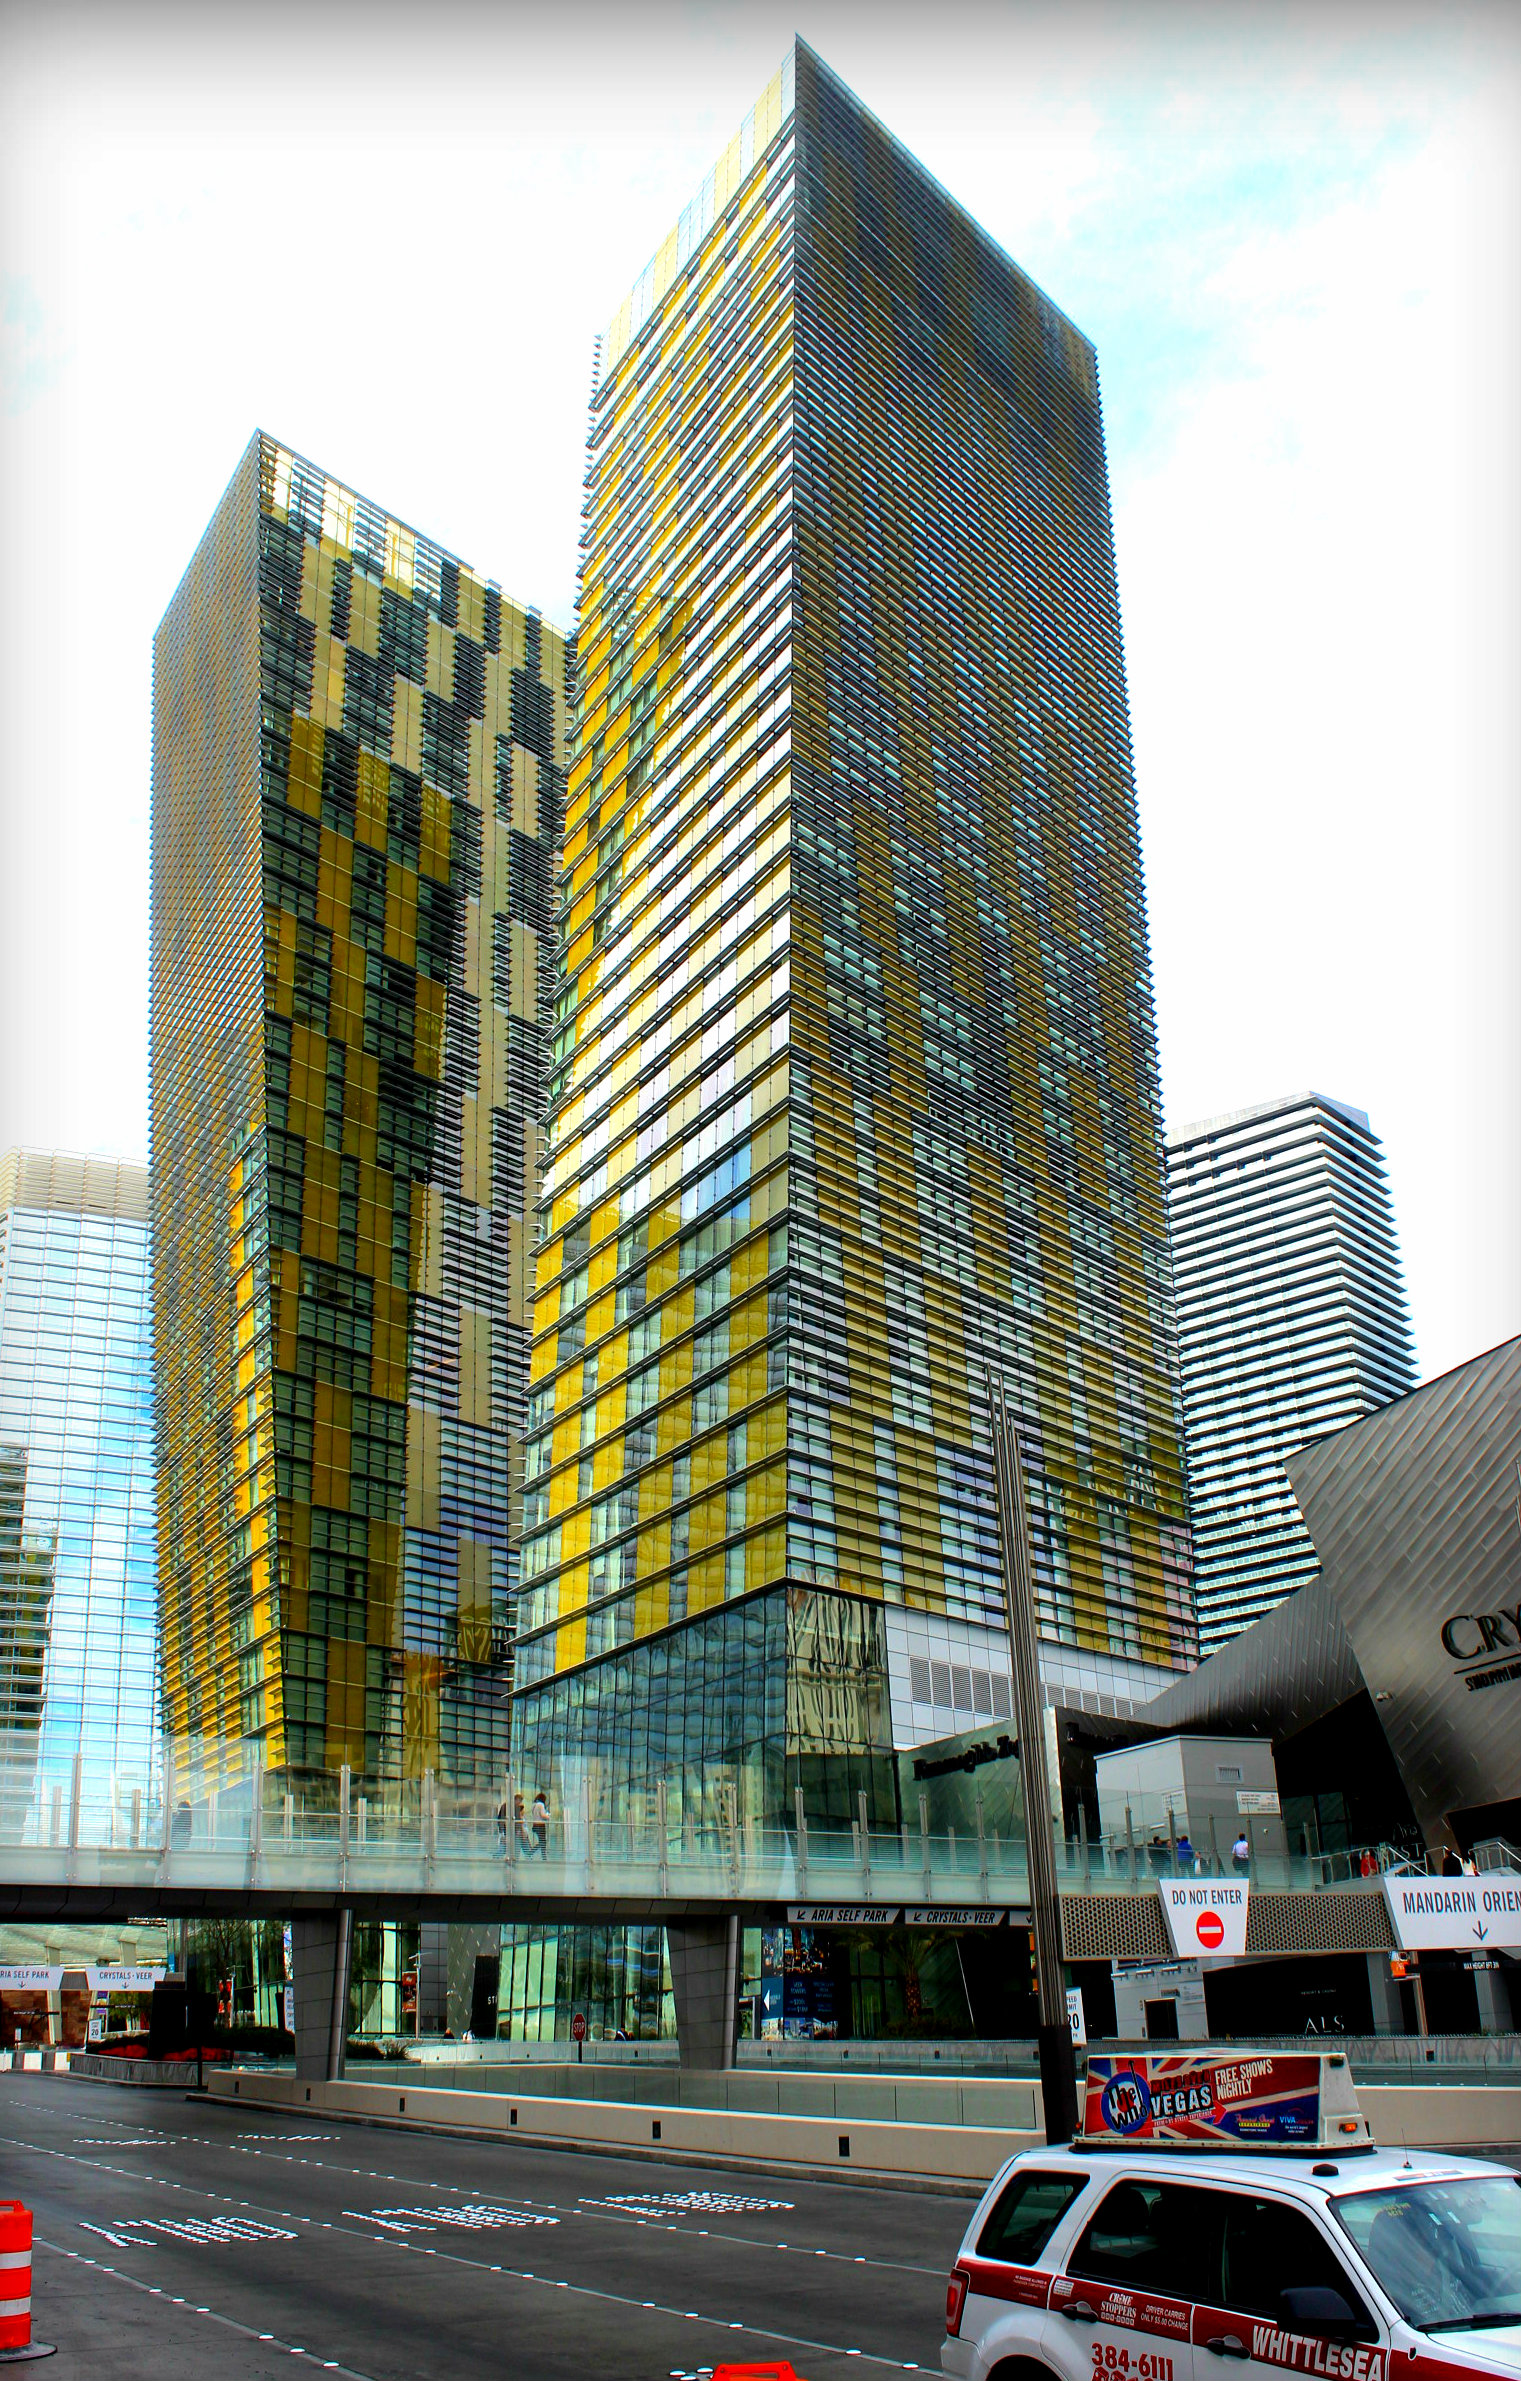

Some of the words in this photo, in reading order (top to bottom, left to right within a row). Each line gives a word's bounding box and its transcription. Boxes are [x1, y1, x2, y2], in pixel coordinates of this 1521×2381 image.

[1172, 1889, 1186, 1905] DO
[1189, 1889, 1209, 1905] NOT
[1212, 1888, 1242, 1905] ENTER
[1403, 1891, 1477, 1914] MANDARIN
[811, 1909, 834, 1921] ARIA
[837, 1909, 860, 1922] SELF
[863, 1909, 888, 1922] PARK
[926, 1911, 967, 1923] CRYSTALS
[974, 1912, 995, 1924] VEER
[13, 1970, 30, 1979] SELF
[32, 1971, 50, 1979] PARK
[99, 1971, 131, 1980] CRYSTALS
[136, 1971, 153, 1980] VEER
[574, 2020, 586, 2033] STOP
[1215, 2066, 1239, 2085] FREE
[1240, 2059, 1273, 2080] SHOWS
[1150, 2085, 1213, 2119] VEGAS
[1280, 2116, 1296, 2124] VIVA
[1101, 2300, 1137, 2318] STOPPERS
[1145, 2304, 1164, 2316] DRIVER
[1164, 2308, 1186, 2321] CARRIES
[1141, 2312, 1154, 2323] ONLY
[1167, 2317, 1188, 2331] CHANGE
[1091, 2342, 1173, 2381] 384-6111
[1252, 2325, 1382, 2381] WHITTLESEA
